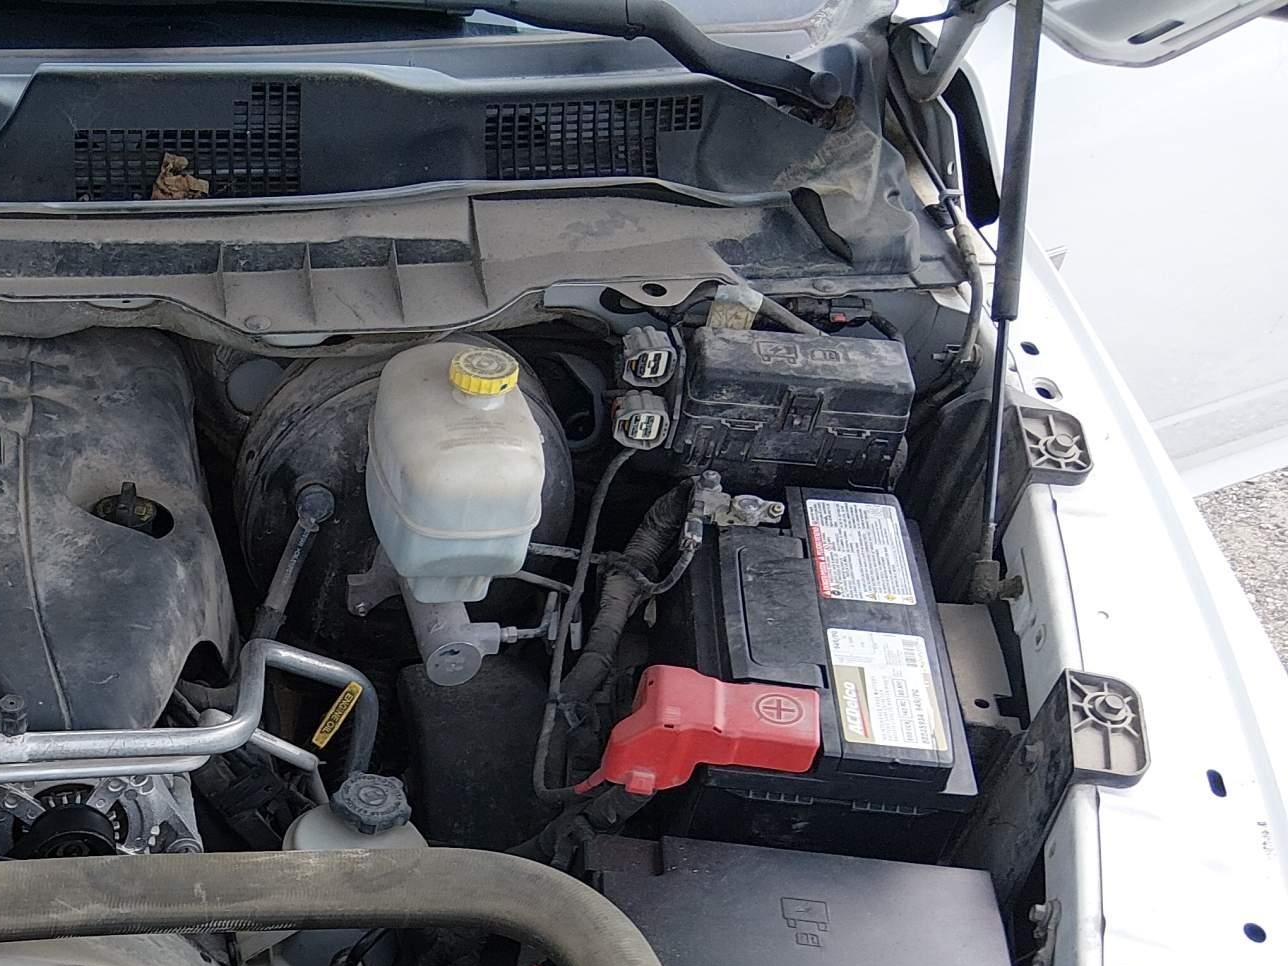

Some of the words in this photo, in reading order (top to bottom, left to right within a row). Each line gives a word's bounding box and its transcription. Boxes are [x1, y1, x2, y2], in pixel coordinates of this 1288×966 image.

[330, 692, 353, 723] ENGINE
[843, 681, 865, 737] ACDelco
[321, 720, 335, 735] OIL
